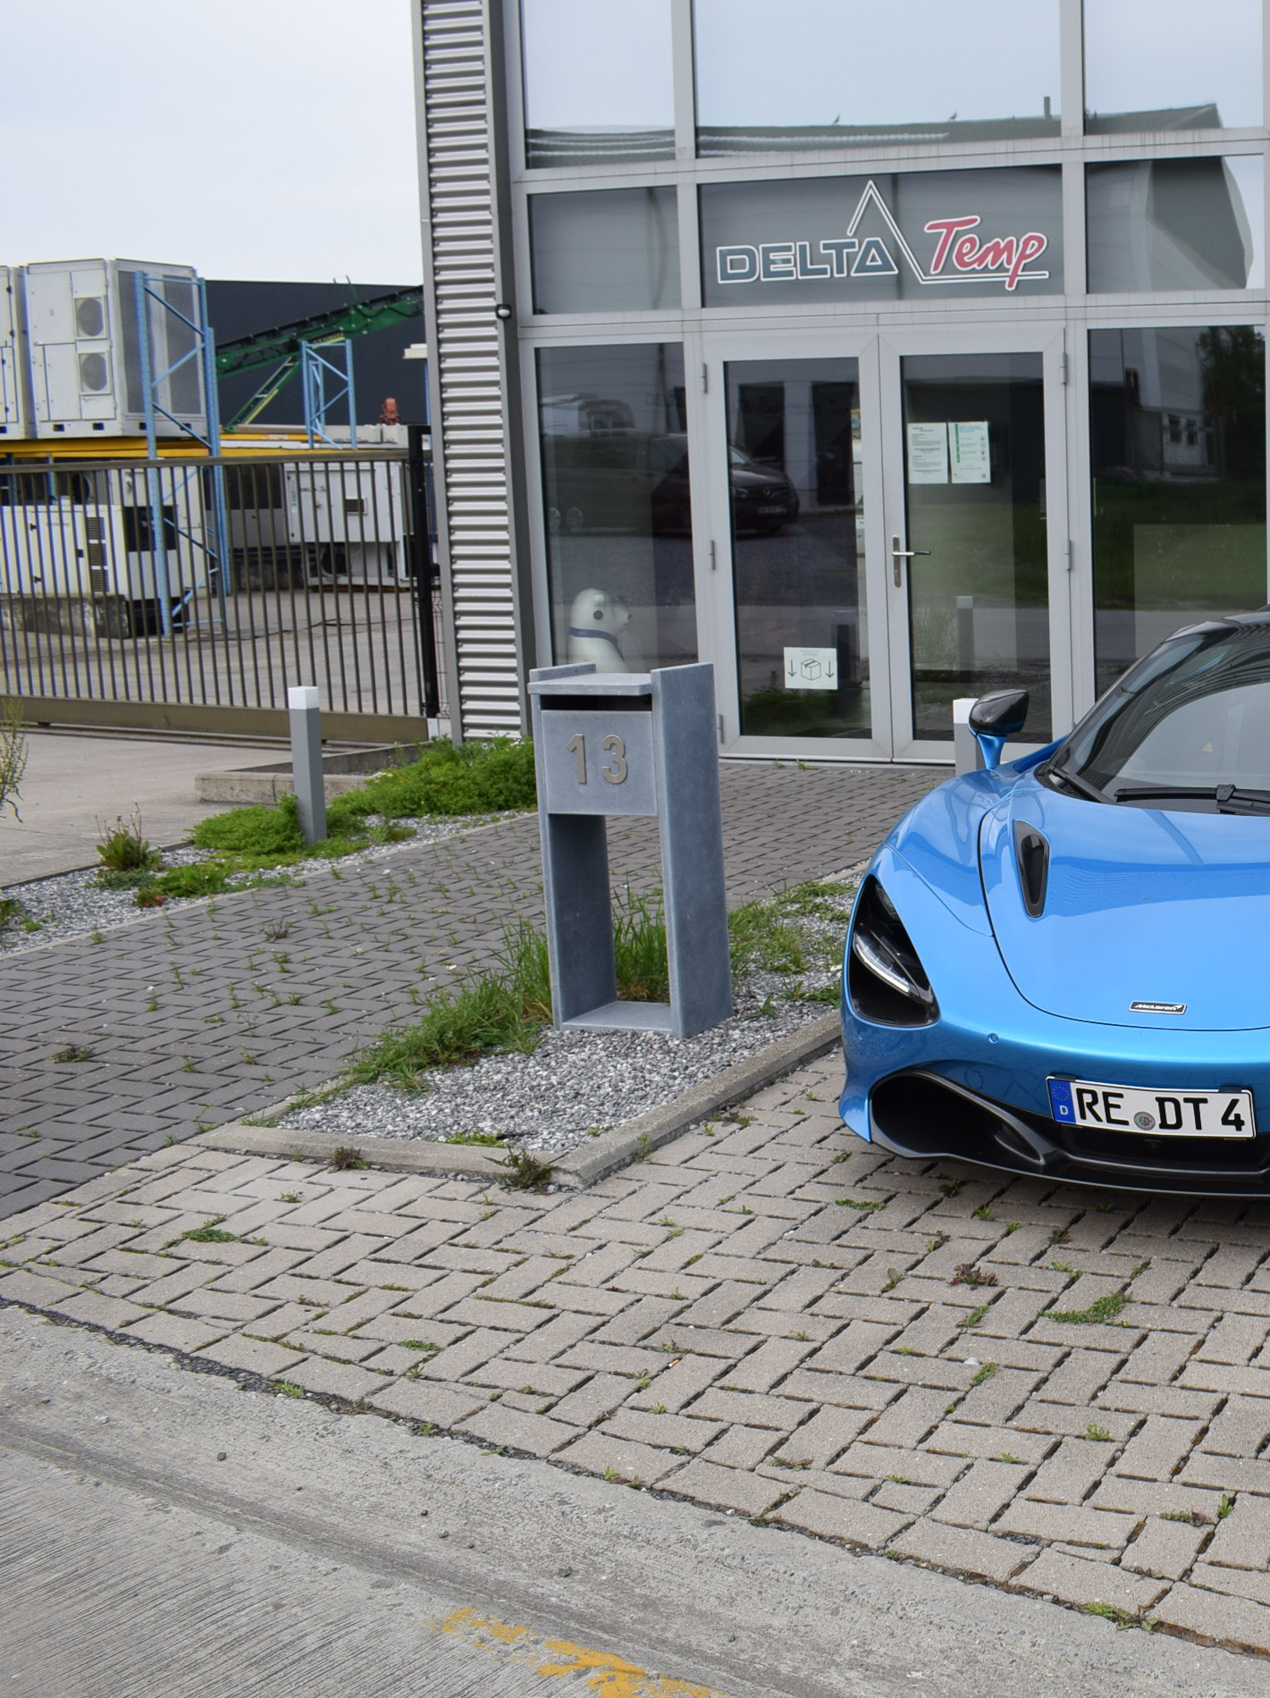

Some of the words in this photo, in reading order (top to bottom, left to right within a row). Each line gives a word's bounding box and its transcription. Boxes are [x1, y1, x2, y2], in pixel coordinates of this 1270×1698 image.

[716, 237, 899, 284] DELTA
[924, 215, 1047, 290] Temp
[566, 733, 628, 785] 13
[1059, 1104, 1069, 1115] D
[1076, 1087, 1129, 1126] RE
[1155, 1096, 1208, 1130] DT
[1221, 1098, 1245, 1132] 4
